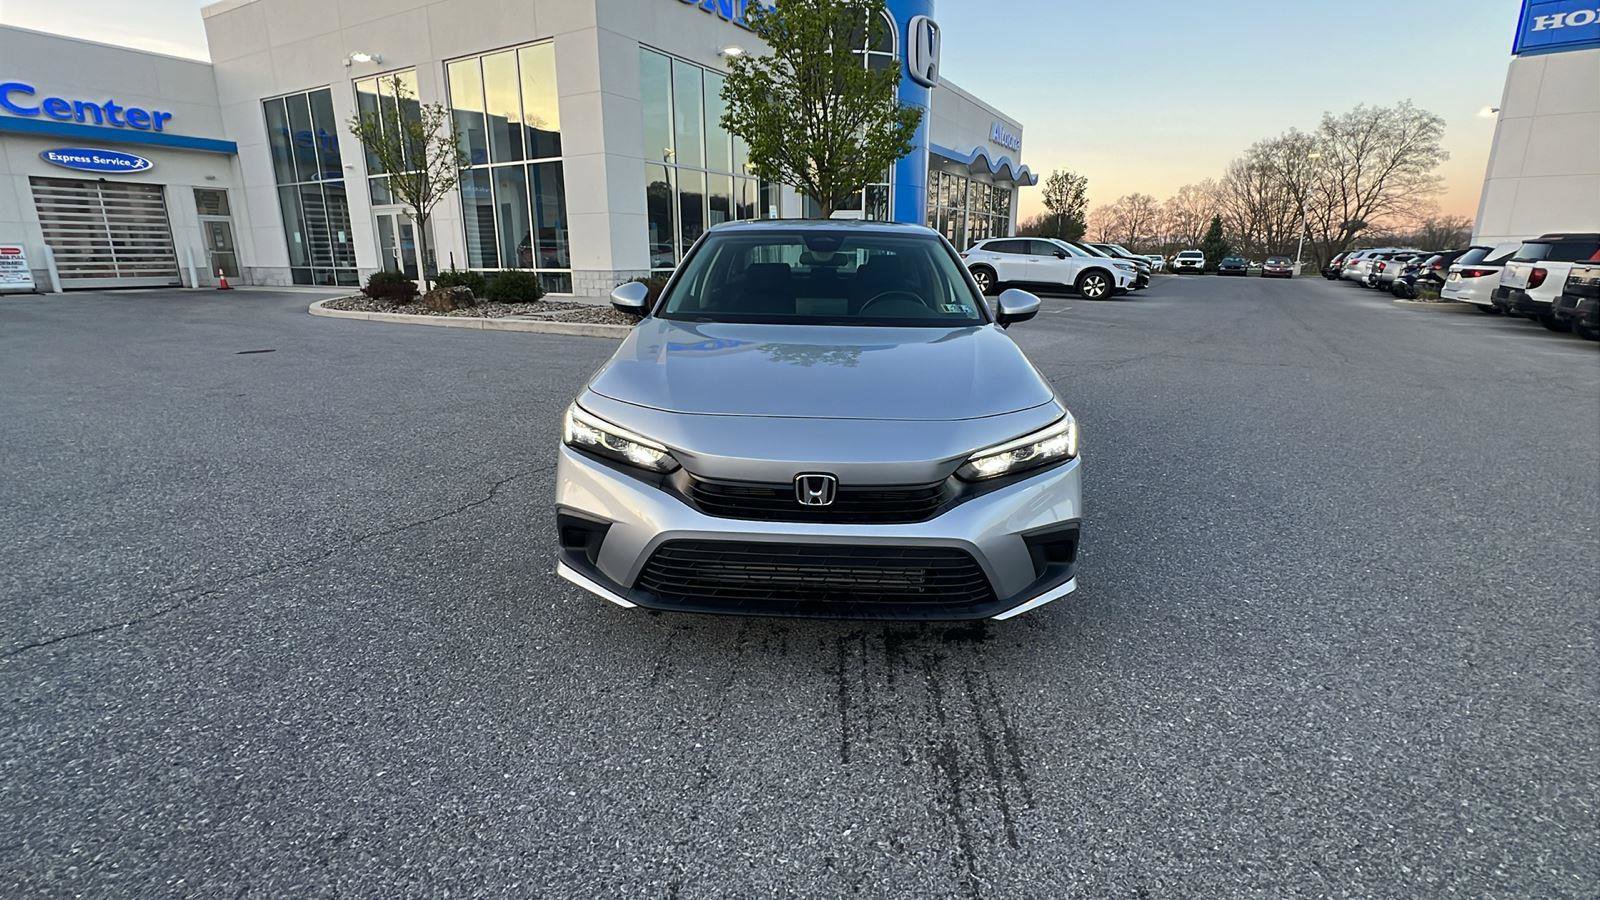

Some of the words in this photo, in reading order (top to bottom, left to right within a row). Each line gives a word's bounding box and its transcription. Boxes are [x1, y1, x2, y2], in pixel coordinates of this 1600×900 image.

[1531, 8, 1600, 31] HO
[0, 82, 172, 131] Center
[48, 152, 91, 163] Express
[92, 155, 131, 166] Service
